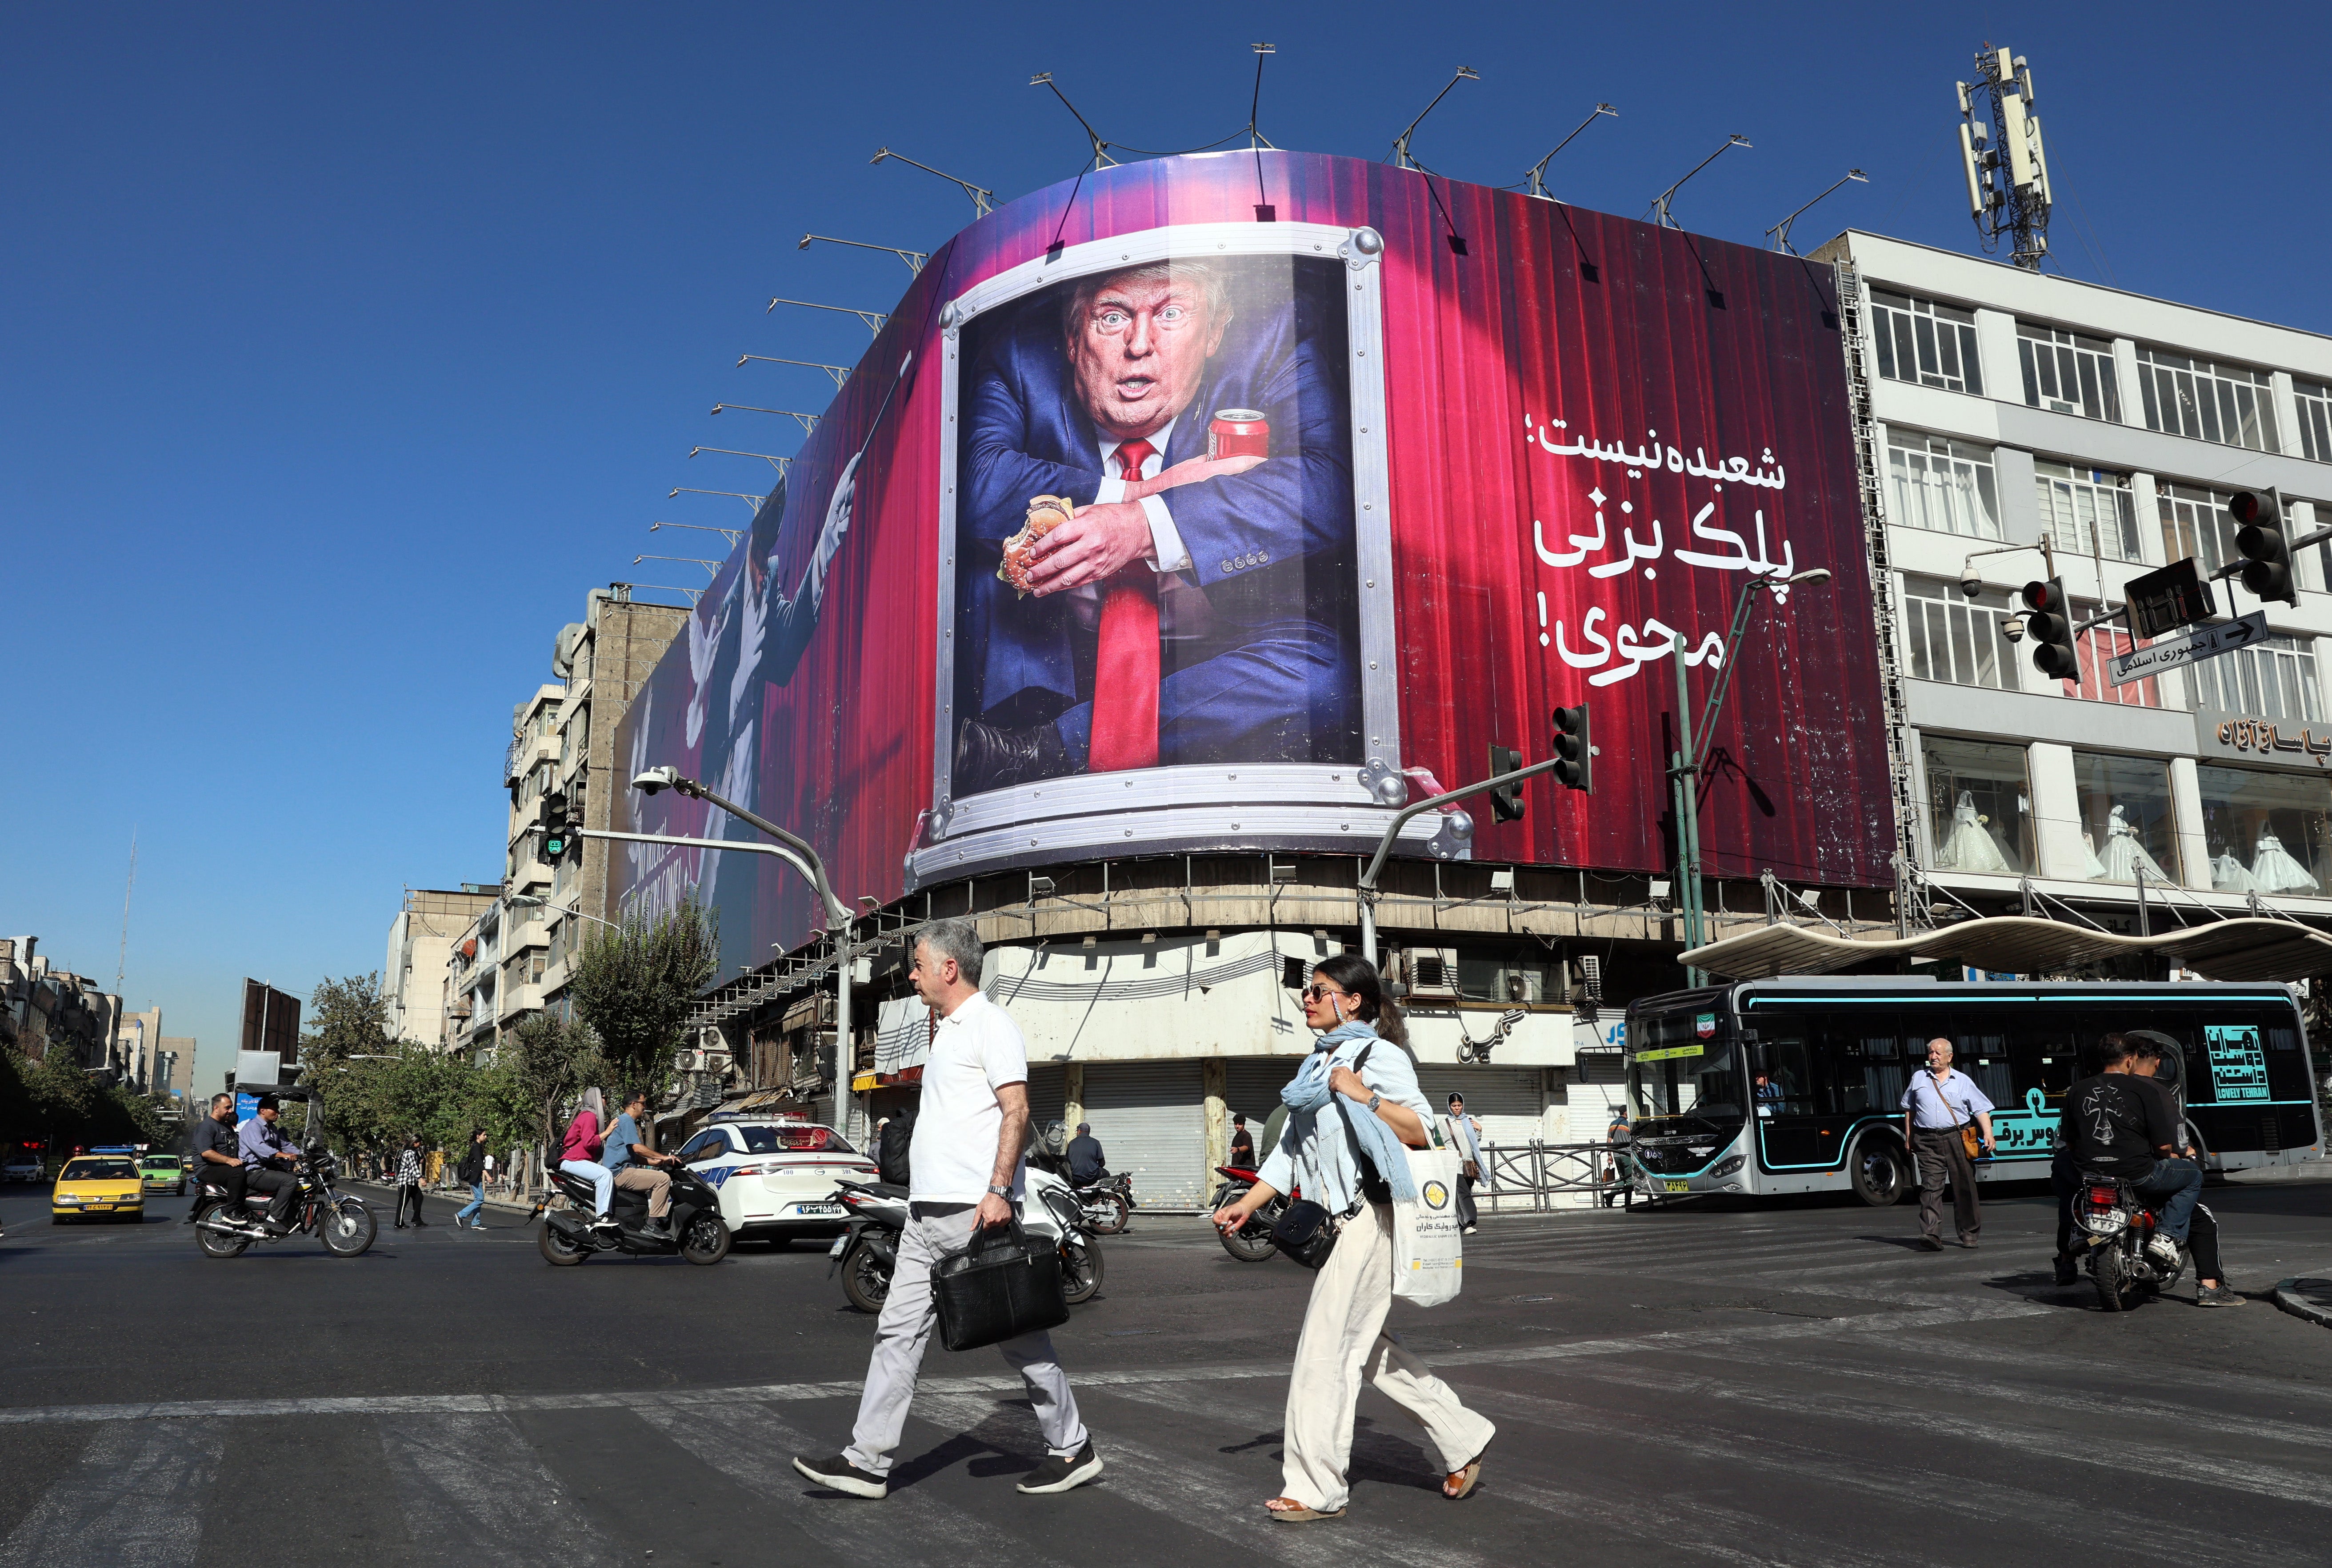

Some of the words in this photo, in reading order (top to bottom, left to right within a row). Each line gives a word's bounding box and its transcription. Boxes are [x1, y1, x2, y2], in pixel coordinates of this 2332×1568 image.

[1667, 446, 1786, 492] شعبده
[1534, 486, 1663, 580] بزنی
[1674, 502, 1794, 604] پلک
[2159, 640, 2207, 662] جمهوری
[2117, 653, 2156, 677] اسلامی
[2260, 720, 2332, 764] پاساژ
[2217, 1088, 2240, 1099] LOVELY
[2241, 1087, 2268, 1098] TEHRAN
[1994, 1122, 2024, 1148] برق
[1416, 1222, 1433, 1232] کاران
